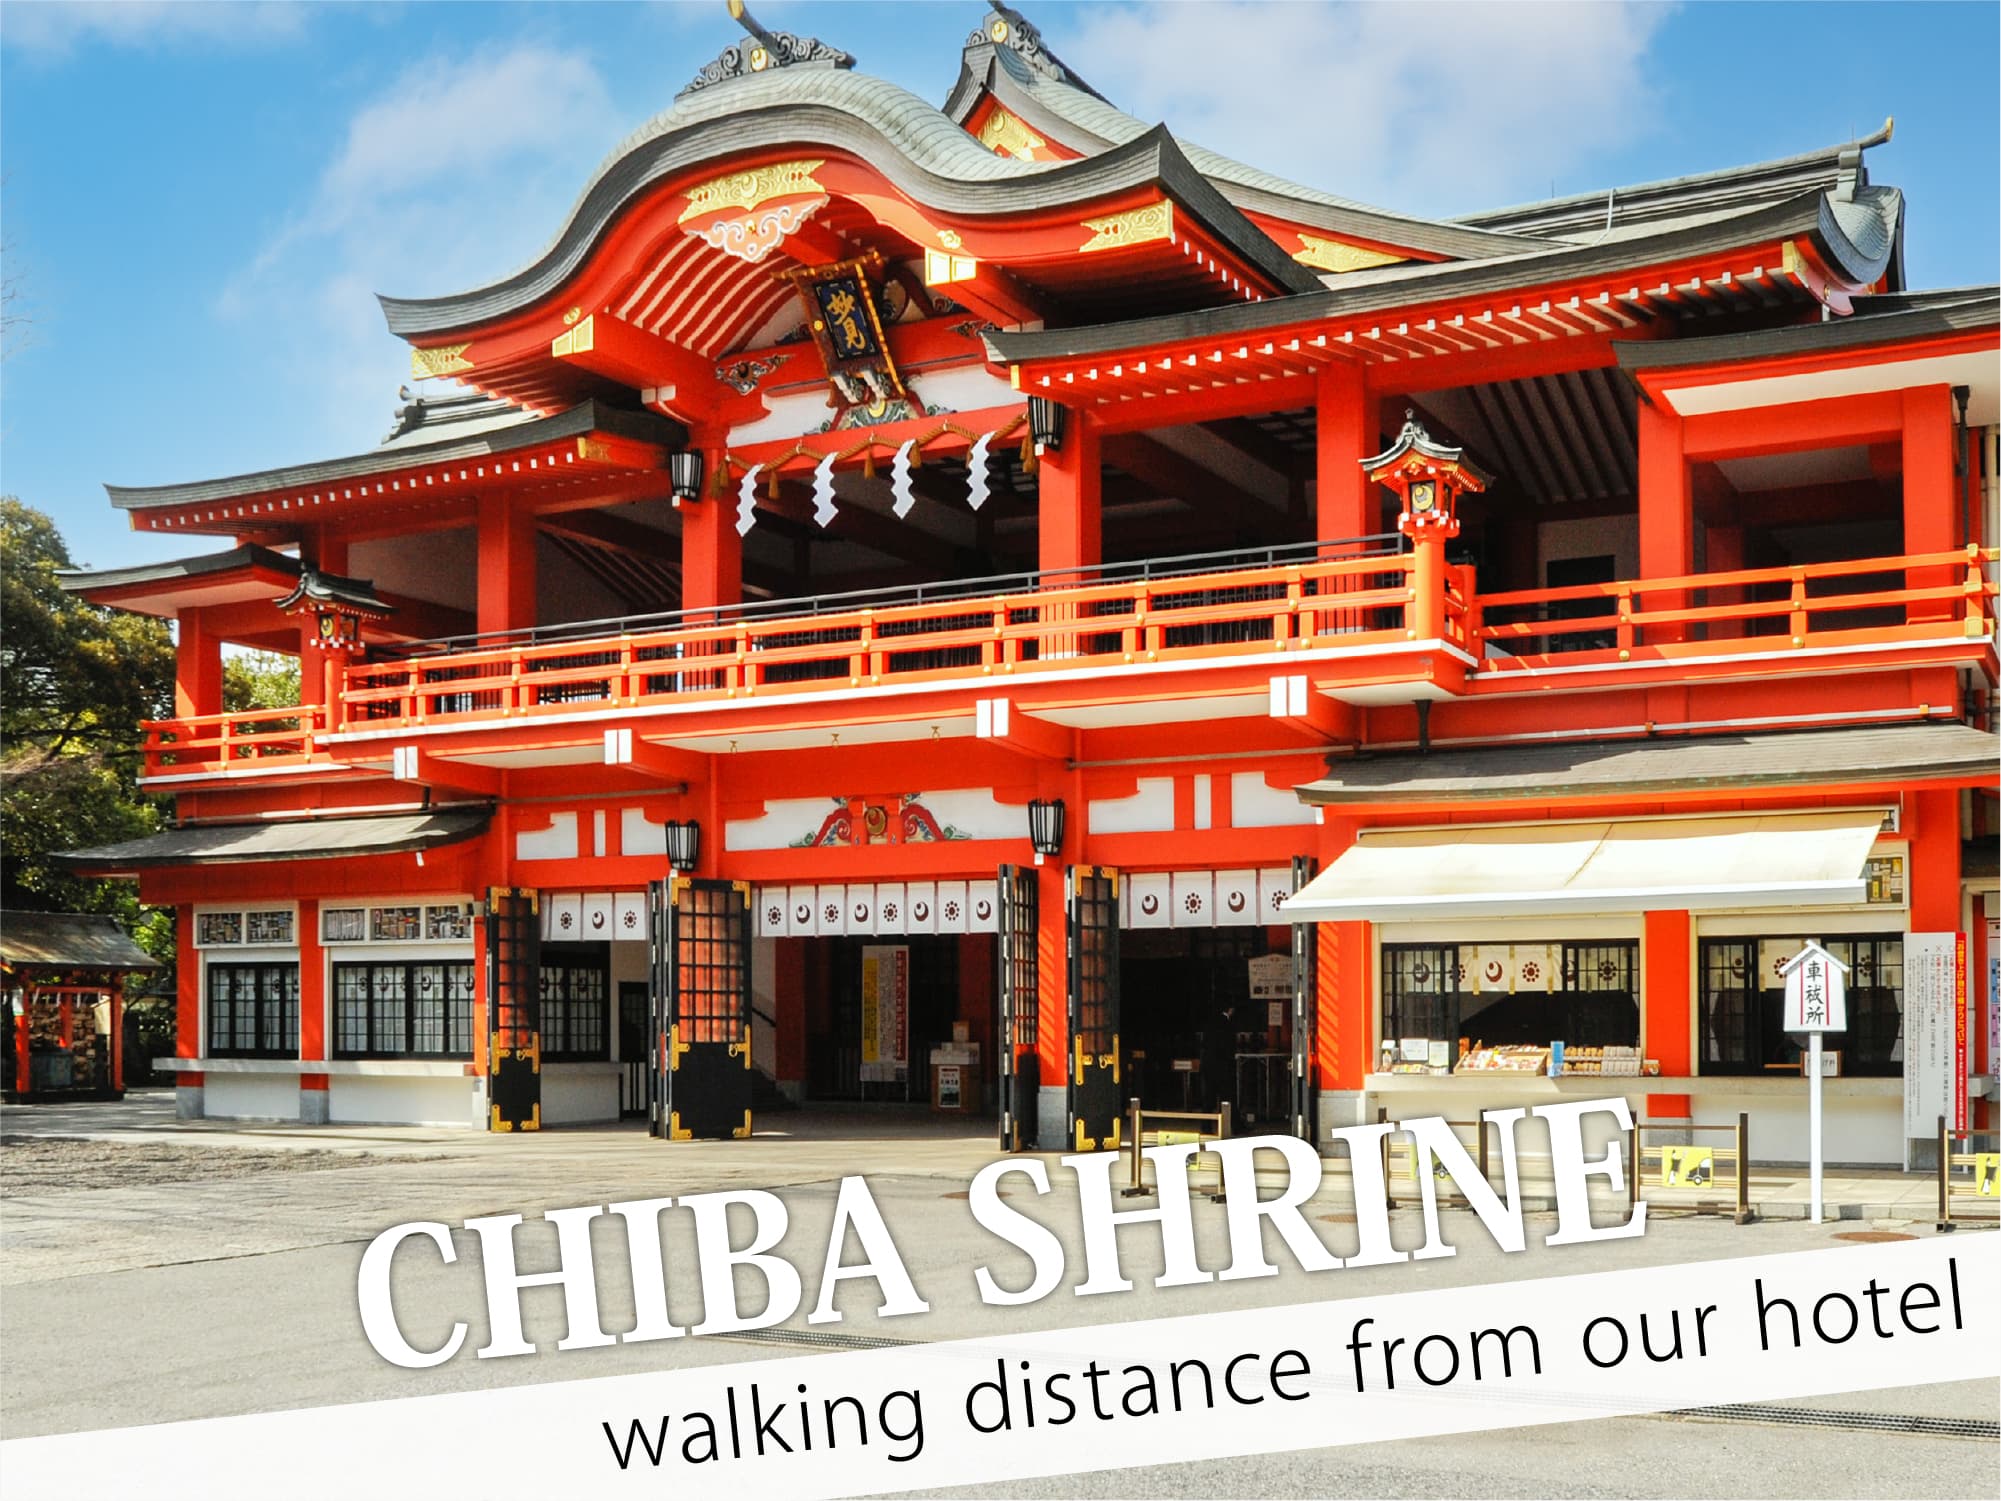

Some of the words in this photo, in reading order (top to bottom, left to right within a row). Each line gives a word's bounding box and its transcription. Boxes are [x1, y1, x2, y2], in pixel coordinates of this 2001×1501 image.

[825, 290, 867, 350] 妙見
[1805, 960, 1825, 1025] 車祓所
